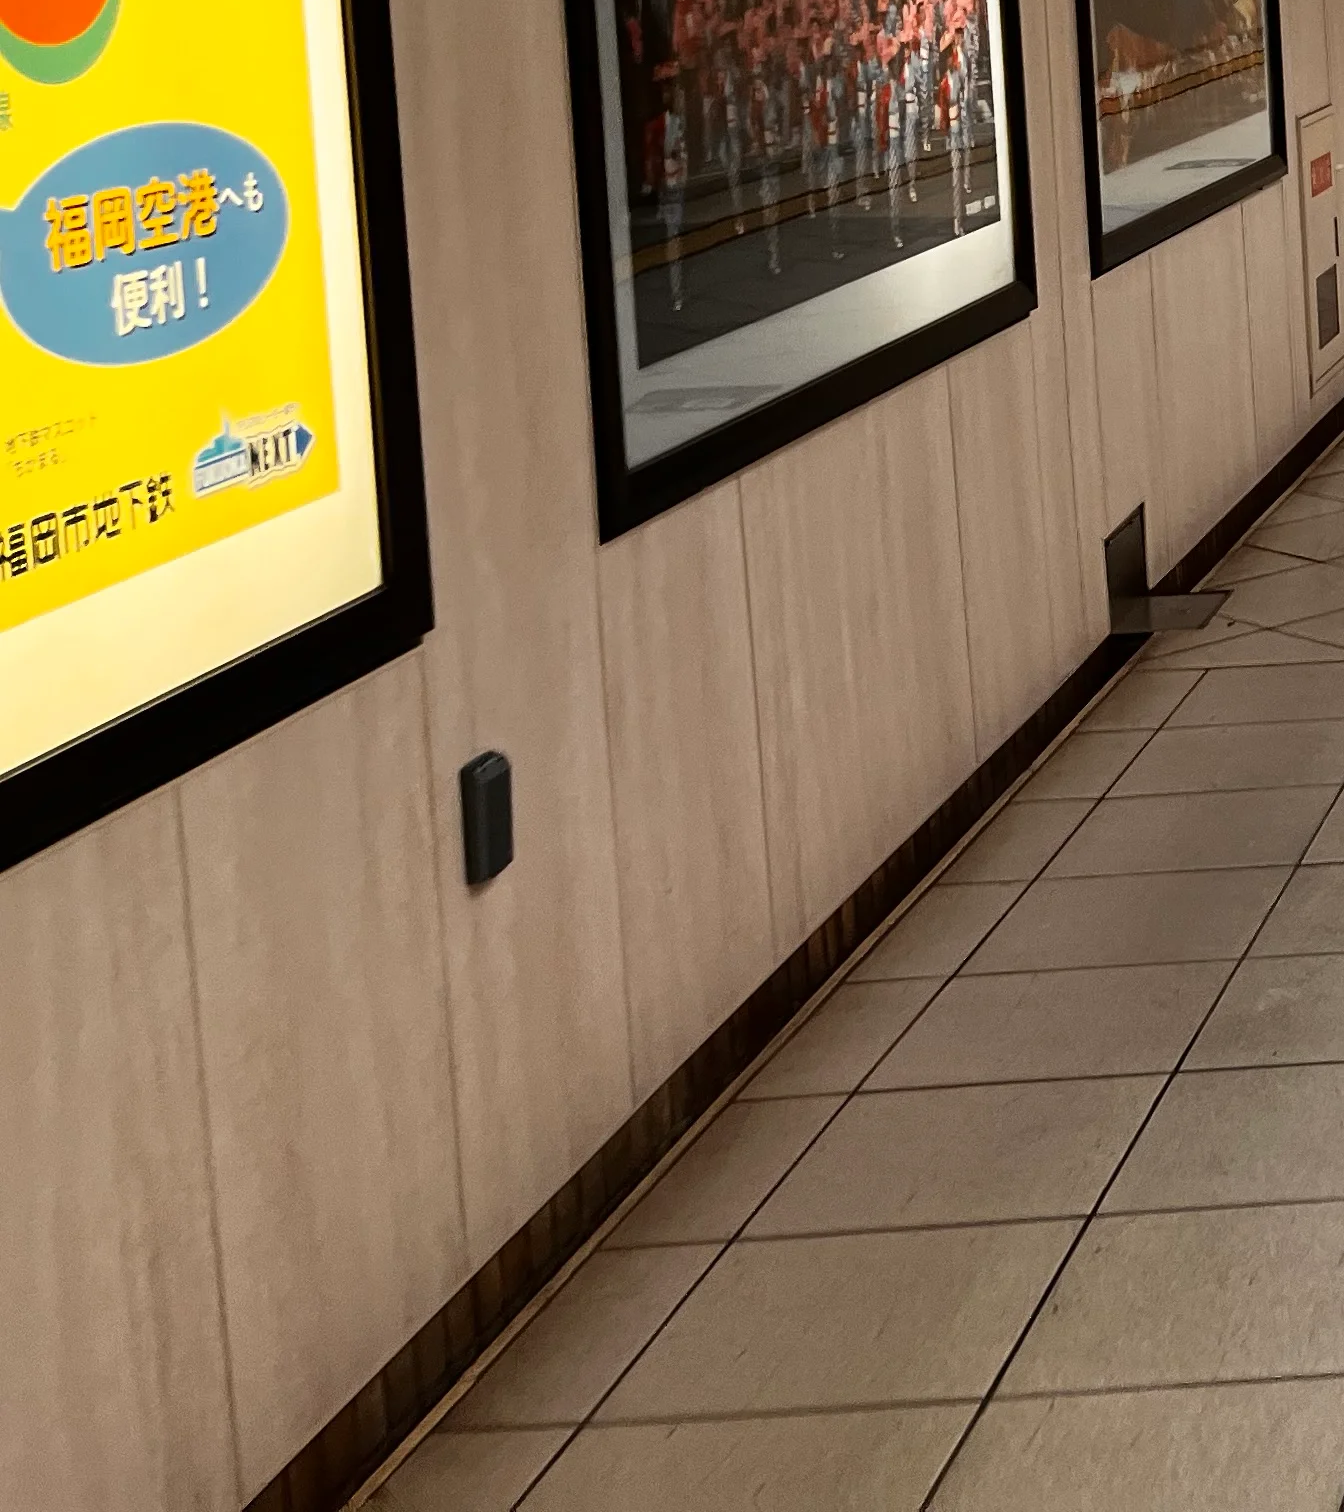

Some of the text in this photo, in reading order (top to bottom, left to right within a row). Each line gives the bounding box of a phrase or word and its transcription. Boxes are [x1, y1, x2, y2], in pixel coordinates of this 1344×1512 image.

[44, 168, 265, 273] 福岡空港へも
[0, 471, 175, 583] 福岡市地下鉄
